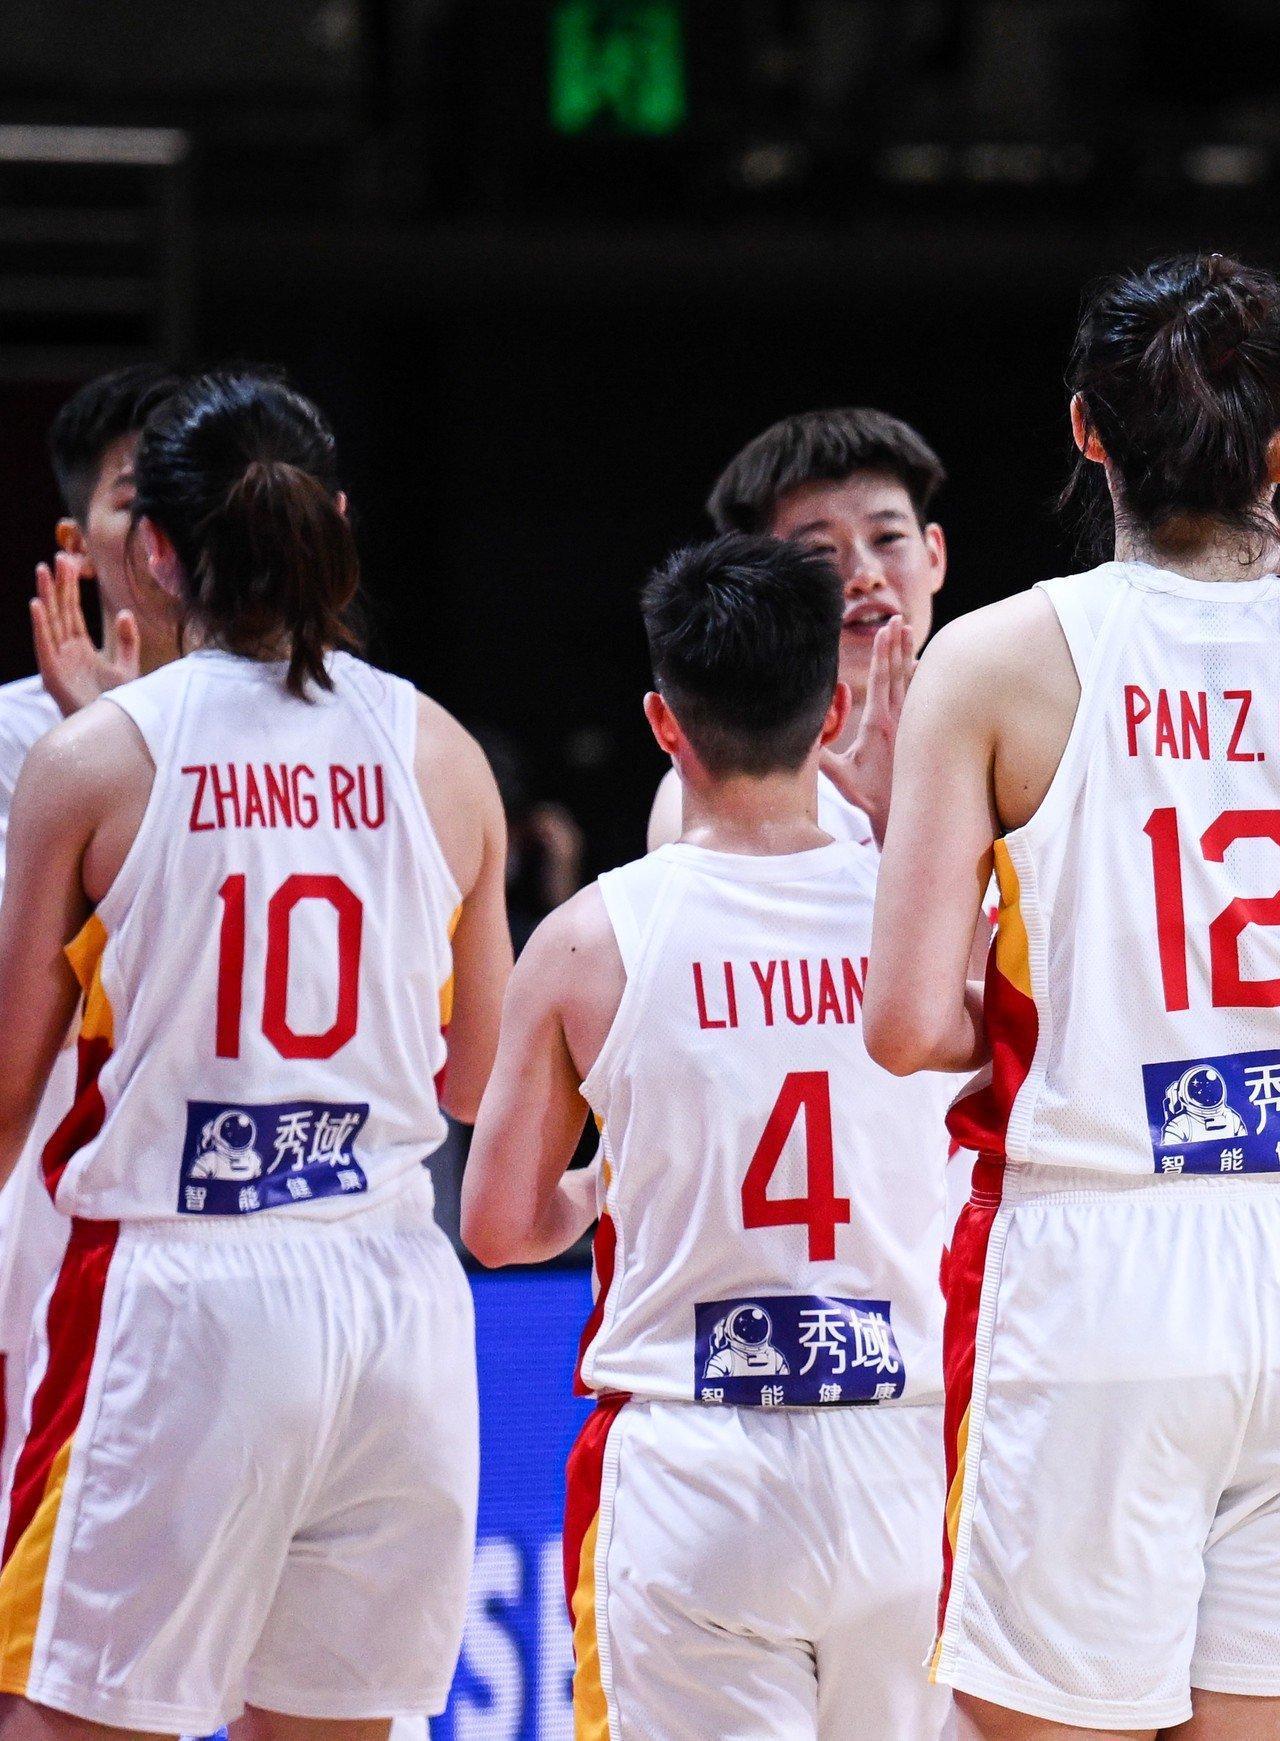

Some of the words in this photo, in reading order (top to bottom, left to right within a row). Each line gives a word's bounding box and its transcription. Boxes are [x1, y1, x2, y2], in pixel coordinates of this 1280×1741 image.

[1124, 685, 1210, 760] PAN
[1223, 690, 1265, 762] Z.
[182, 765, 317, 832] ZHANG
[333, 765, 386, 830] RU
[216, 872, 363, 1060] 10
[692, 961, 738, 1030] LI
[750, 957, 869, 1026] YUAN
[267, 1110, 361, 1174] 秀域
[741, 1070, 850, 1262] 4
[798, 1308, 899, 1376] 秀域
[701, 1382, 897, 1406] 智能健康
